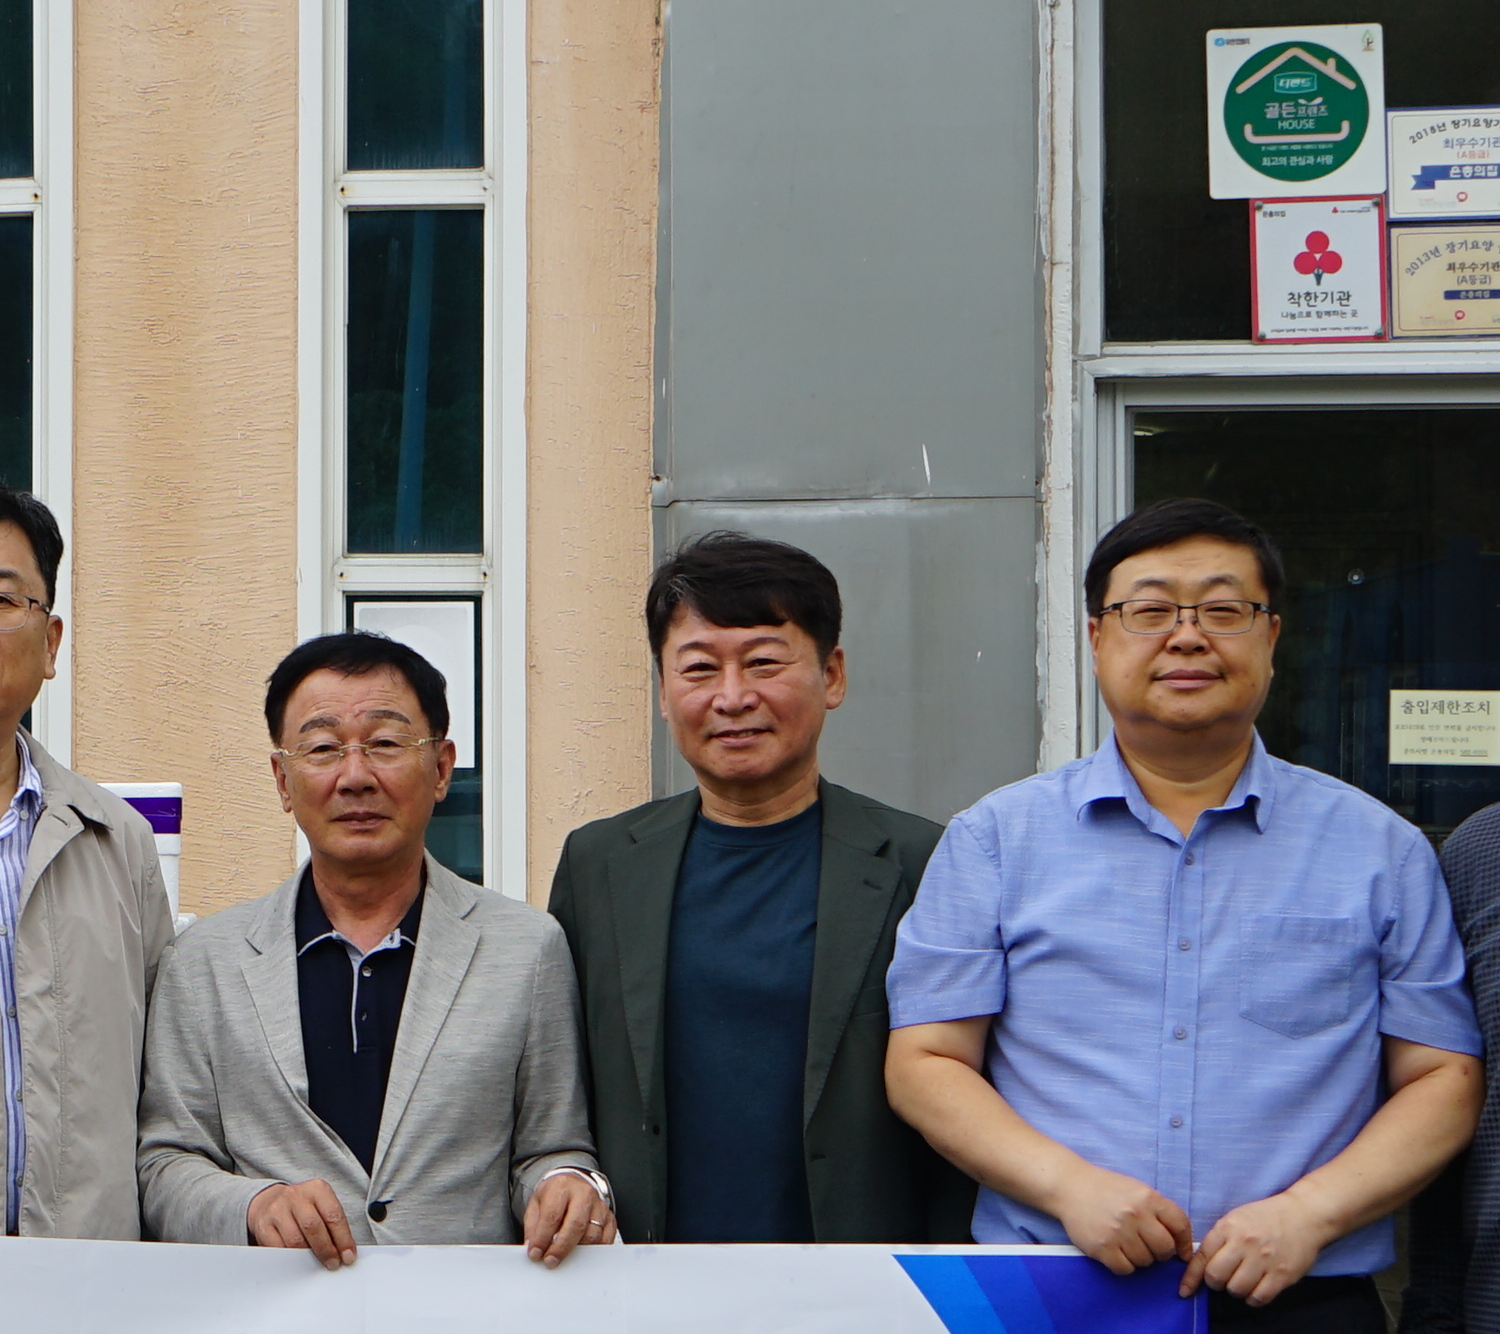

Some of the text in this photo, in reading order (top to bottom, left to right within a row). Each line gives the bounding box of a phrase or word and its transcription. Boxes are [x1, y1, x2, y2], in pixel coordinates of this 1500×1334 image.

[1278, 119, 1316, 130] HOUSE
[1456, 150, 1490, 159] (A등급)
[1450, 165, 1498, 178] 은총의집
[1405, 246, 1442, 277] 2013년
[1446, 240, 1494, 254] 장기요양
[1456, 274, 1492, 286] (A등급)
[1287, 290, 1352, 308] 착한기관
[1281, 309, 1358, 320] 나눔으로 함께하는 곳
[1400, 700, 1491, 715] 출입제한조치
